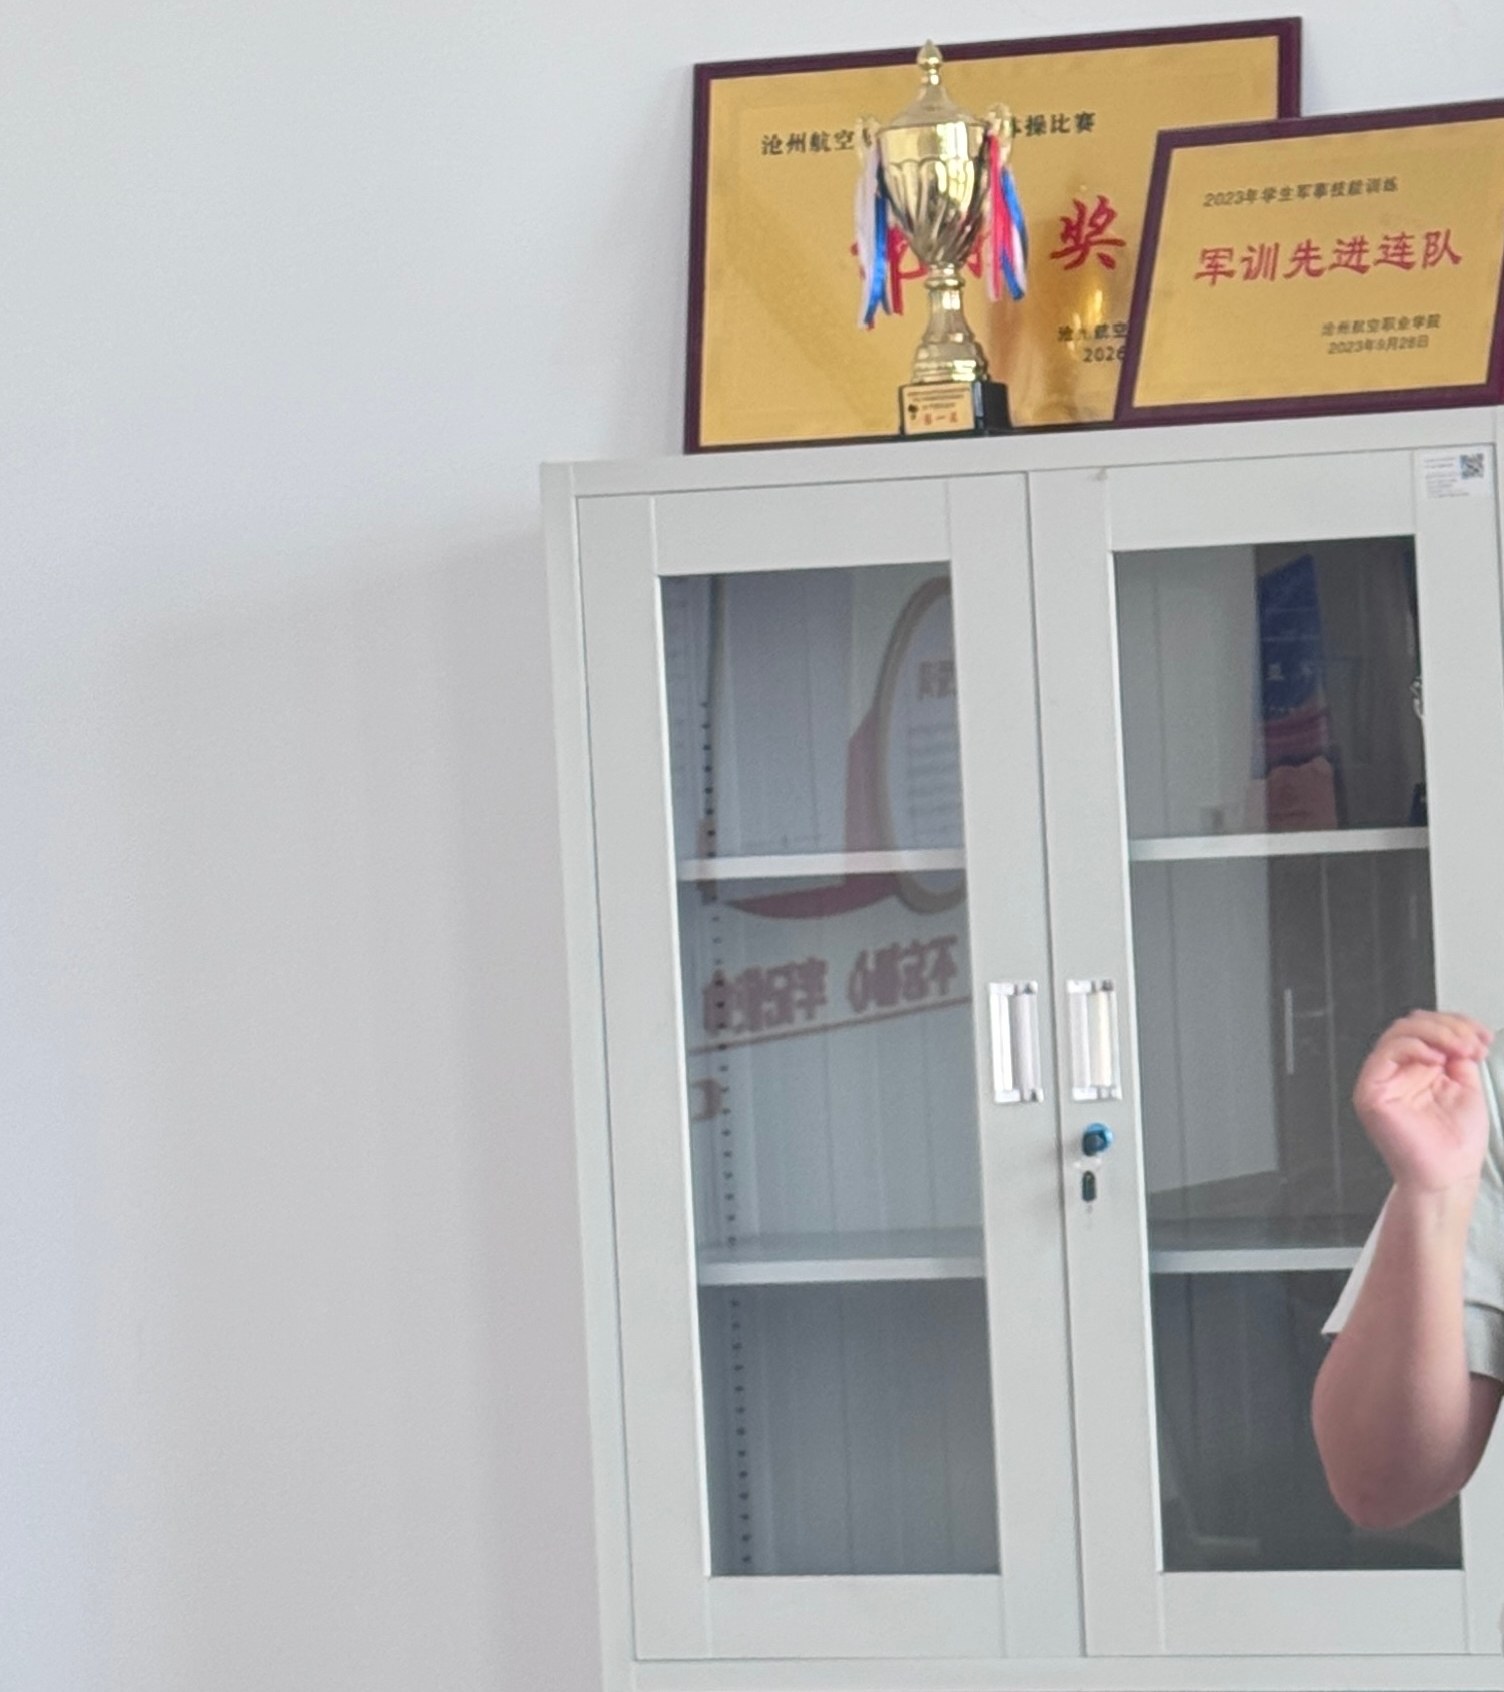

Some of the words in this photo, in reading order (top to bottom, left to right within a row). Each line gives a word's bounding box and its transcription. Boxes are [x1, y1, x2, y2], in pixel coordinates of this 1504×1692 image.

[1203, 176, 1399, 208] 2023年学生军事技能训练
[1195, 229, 1463, 287] 军训先进连队
